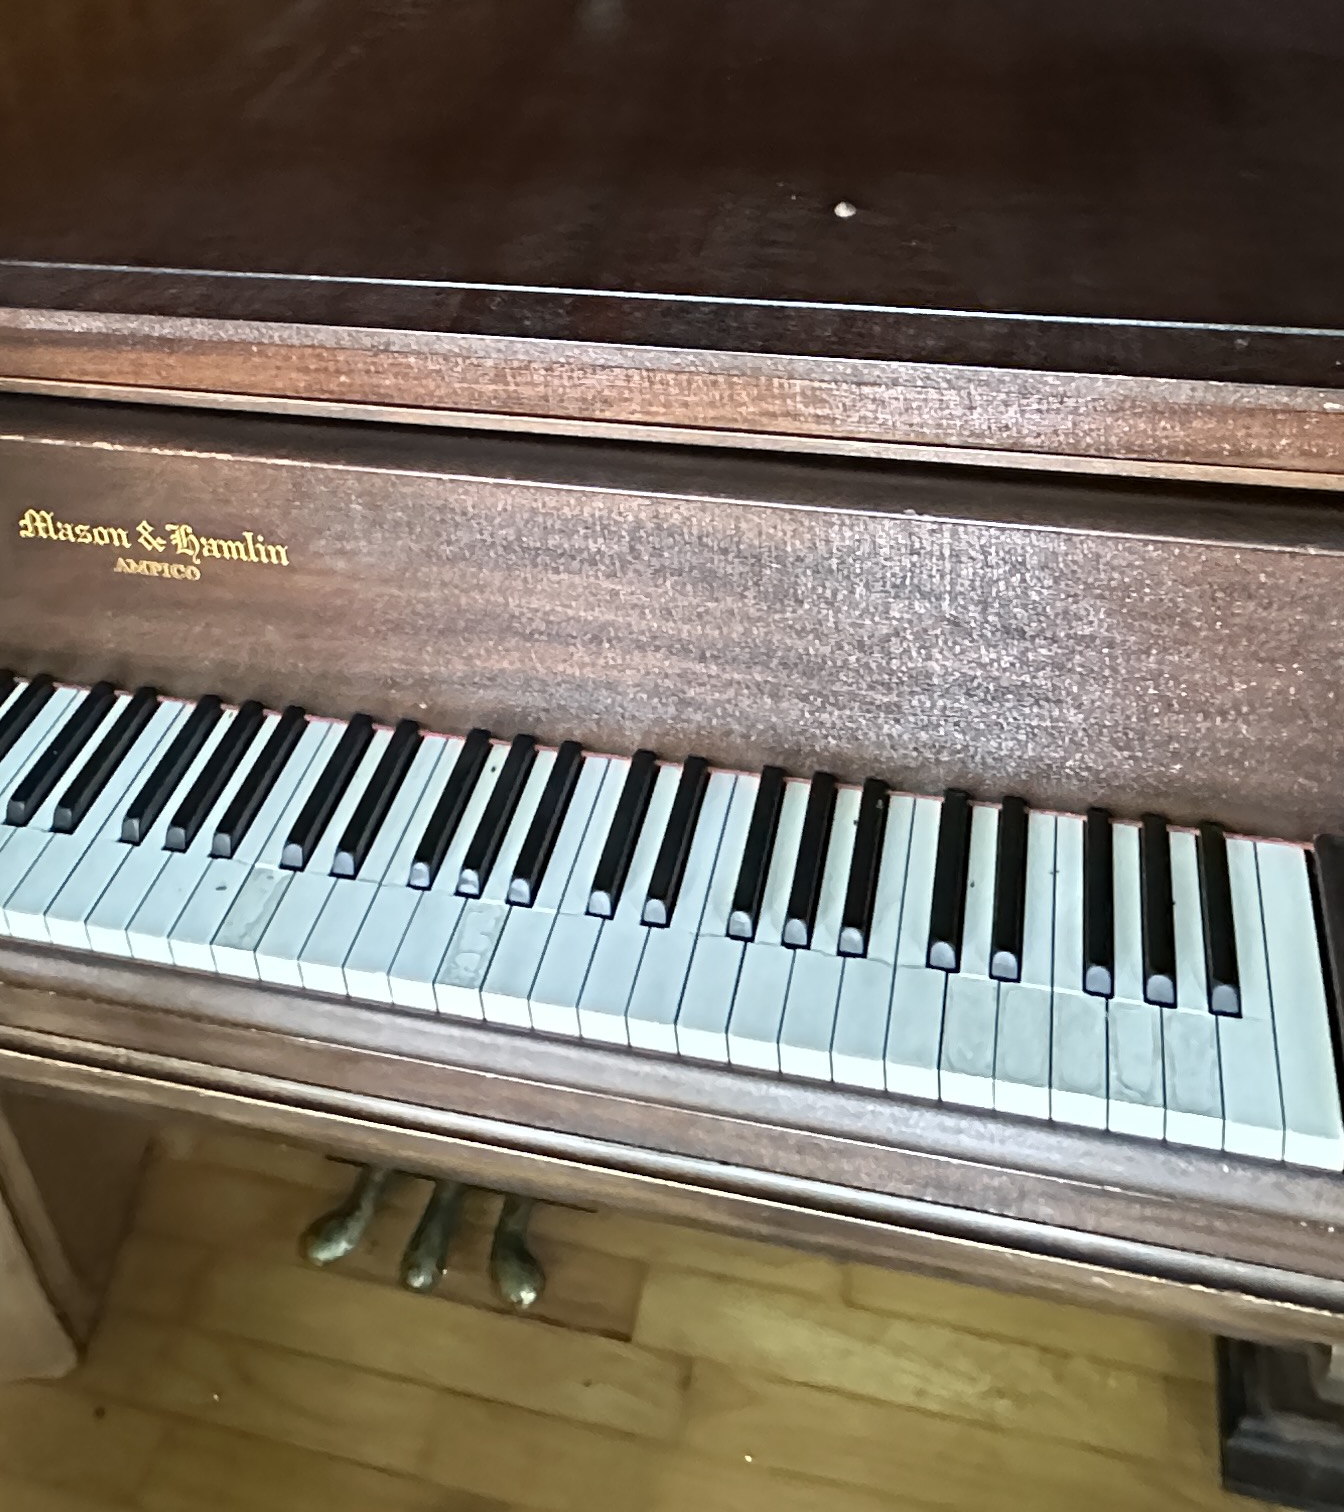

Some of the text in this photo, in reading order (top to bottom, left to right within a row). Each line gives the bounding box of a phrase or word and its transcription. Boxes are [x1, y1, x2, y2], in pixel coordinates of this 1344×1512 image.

[18, 508, 291, 566] Mason & Hamlin
[113, 557, 201, 581] AMPICO
